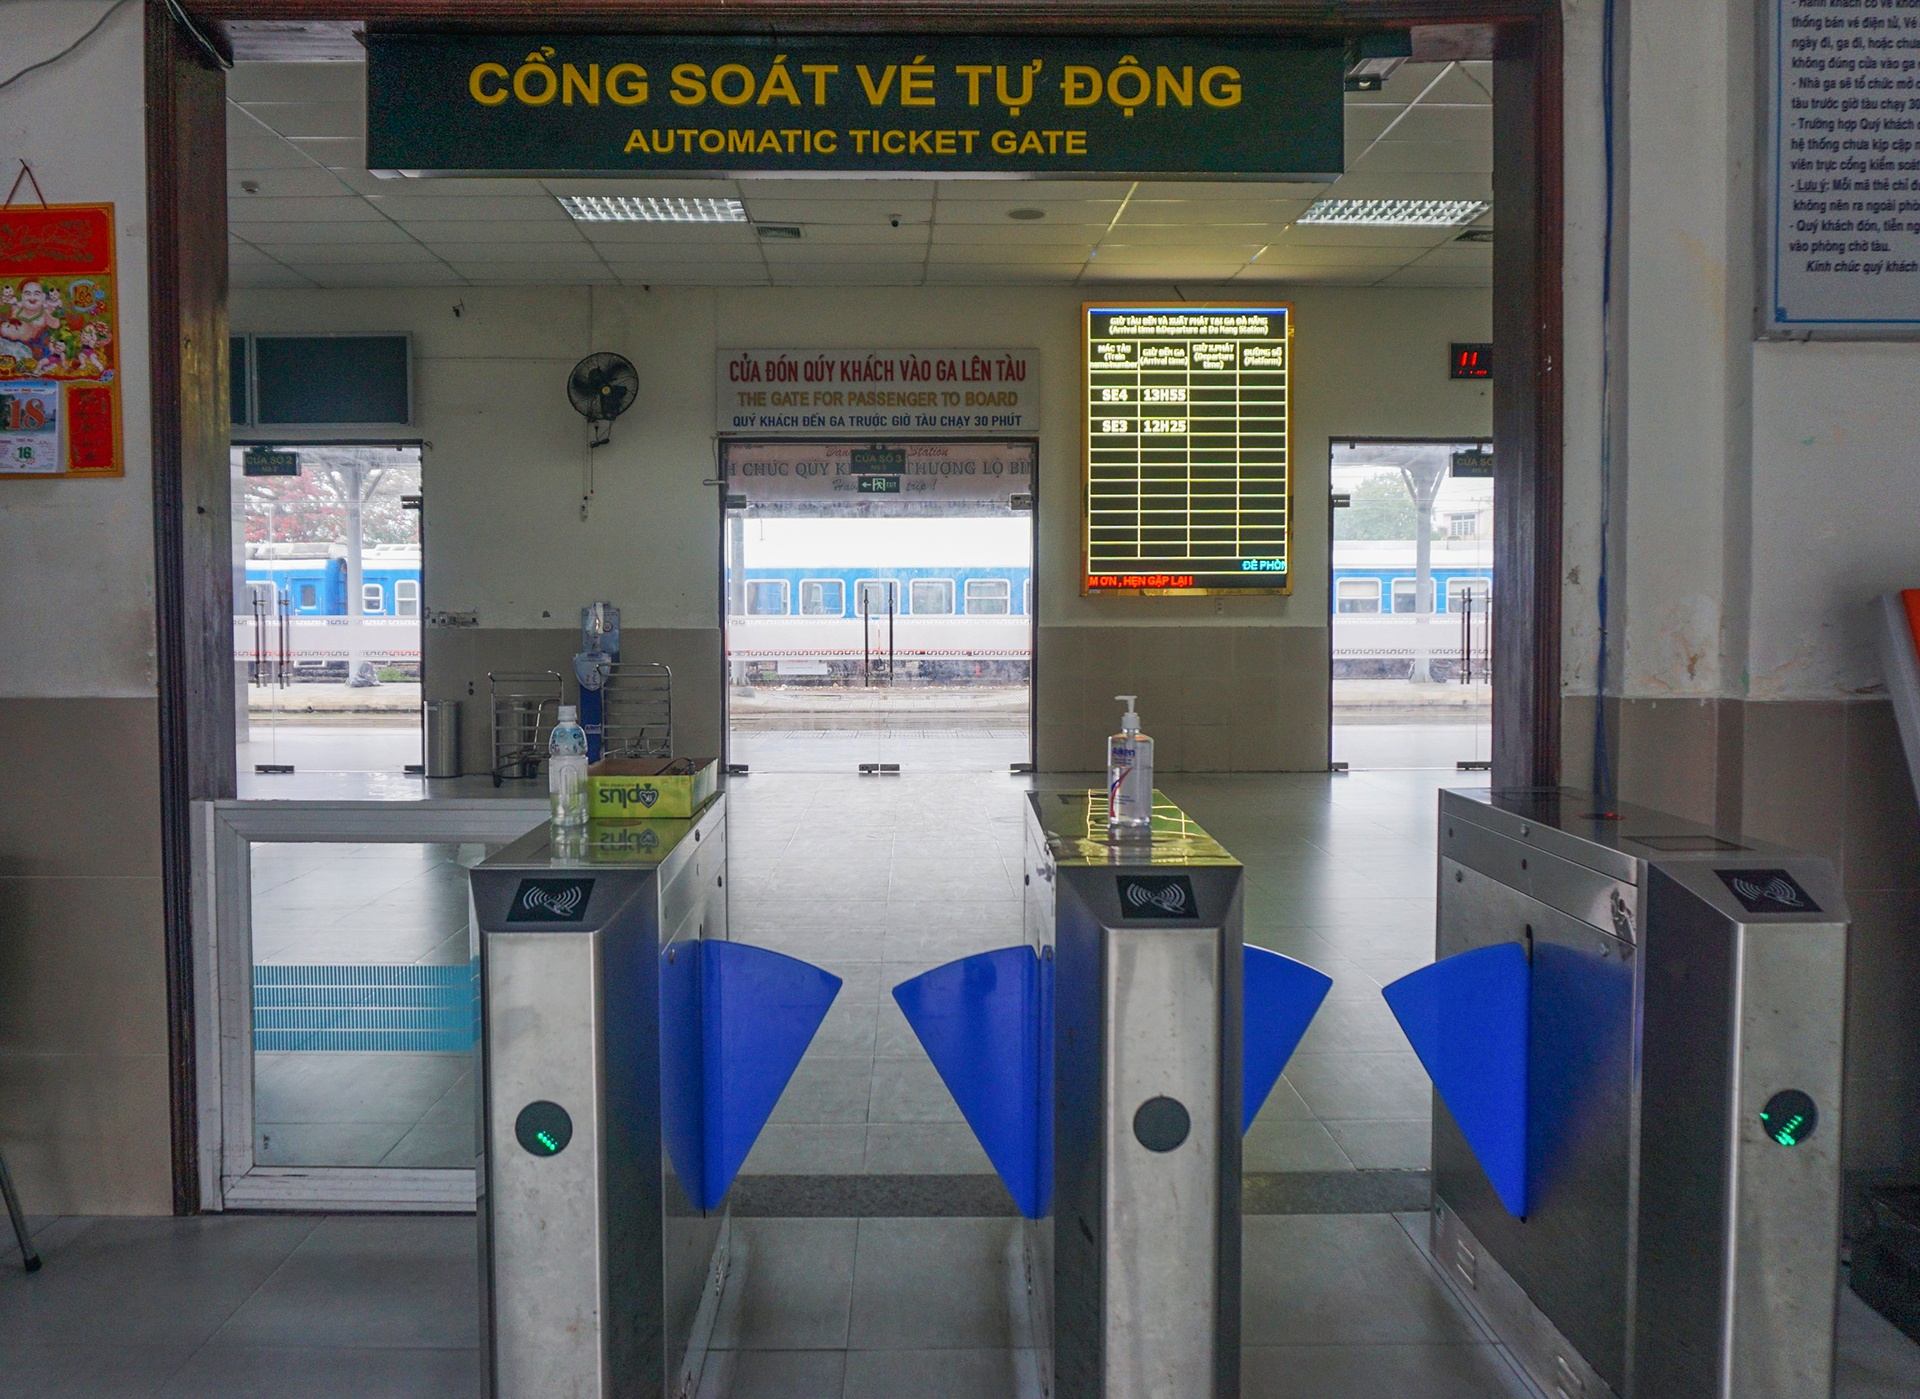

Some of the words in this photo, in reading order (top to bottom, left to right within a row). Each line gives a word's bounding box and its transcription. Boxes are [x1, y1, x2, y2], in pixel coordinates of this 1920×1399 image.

[469, 46, 650, 107] CỔNG
[669, 54, 839, 107] SOÁT
[855, 55, 936, 107] VÉ
[955, 58, 1043, 117] TỰ
[1060, 54, 1243, 118] ĐỘNG
[623, 129, 838, 155] AUTOMATIC
[849, 129, 981, 155] TICKET
[991, 129, 1088, 155] GATE
[729, 352, 761, 382] CỬA
[765, 354, 798, 382] ĐÓN
[804, 354, 836, 382] QÚY
[840, 354, 894, 382] KHÁCH
[899, 354, 931, 382] VÀO
[936, 359, 957, 382] GA
[962, 354, 992, 382] LÊN
[996, 354, 1026, 382] TÀU
[737, 391, 766, 407] THE
[771, 391, 810, 407] GATE
[813, 391, 843, 407] FOR
[847, 391, 938, 407] PASSENGER
[941, 391, 961, 407] TO
[965, 391, 1018, 407] BOARD
[1102, 388, 1128, 401] SE4
[1144, 388, 1186, 401] 13H55
[6, 398, 46, 430] 18
[733, 413, 756, 427] QUÝ
[760, 413, 798, 427] KHÁCH
[803, 412, 826, 427] ĐẾN
[830, 415, 846, 427] GA
[849, 413, 888, 427] TRƯỚC
[892, 413, 911, 427] GIỜ
[915, 413, 937, 427] TÀU
[940, 415, 971, 429] CHẠY
[974, 415, 989, 427] 30
[992, 412, 1022, 427] PHÚT
[1102, 420, 1128, 432] SE3
[1144, 420, 1186, 432] 12H25
[17, 446, 32, 459] 16
[599, 784, 640, 808] plus
